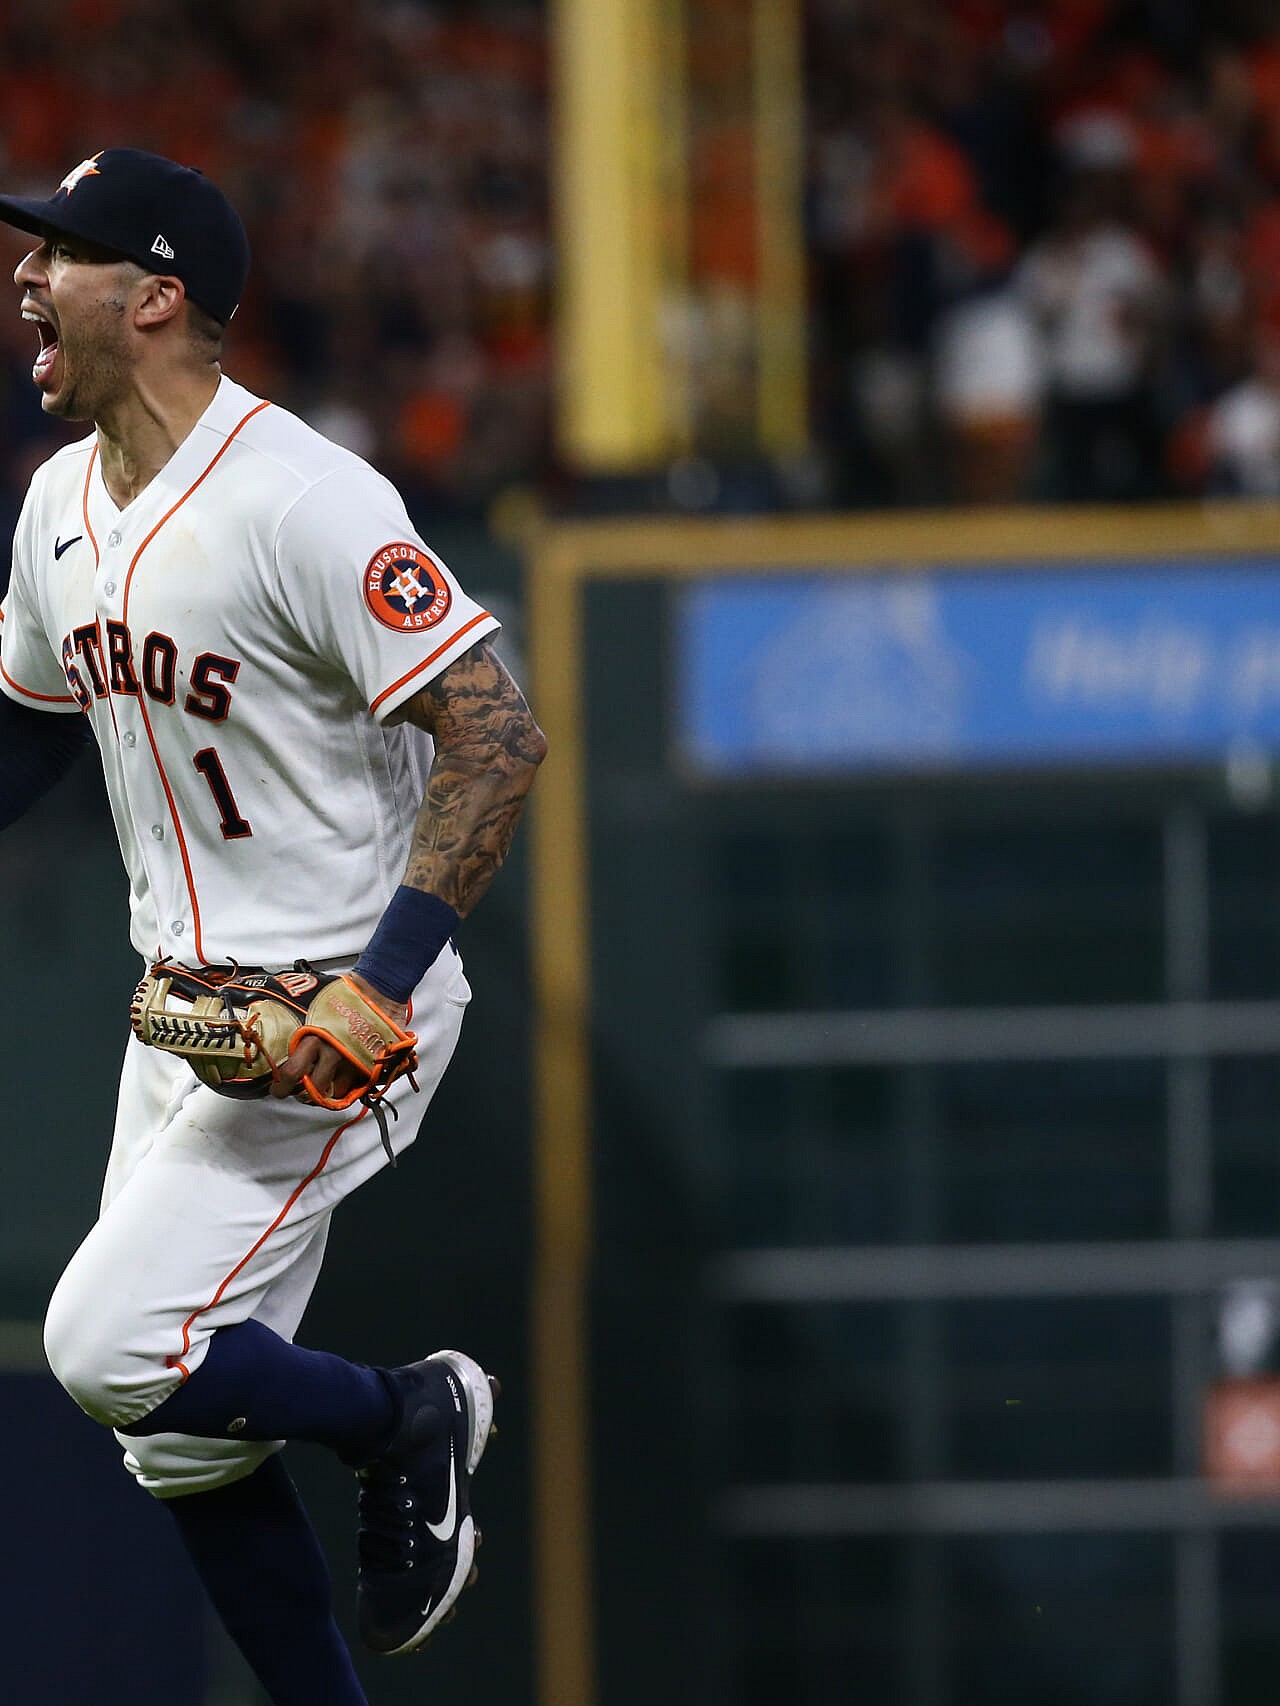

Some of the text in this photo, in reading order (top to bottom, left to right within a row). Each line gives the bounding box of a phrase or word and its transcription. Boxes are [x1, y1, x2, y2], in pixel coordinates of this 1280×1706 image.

[369, 547, 418, 592] HOUSTON
[402, 588, 448, 627] ASTROS
[62, 618, 241, 724] STROS
[192, 746, 253, 840] 1
